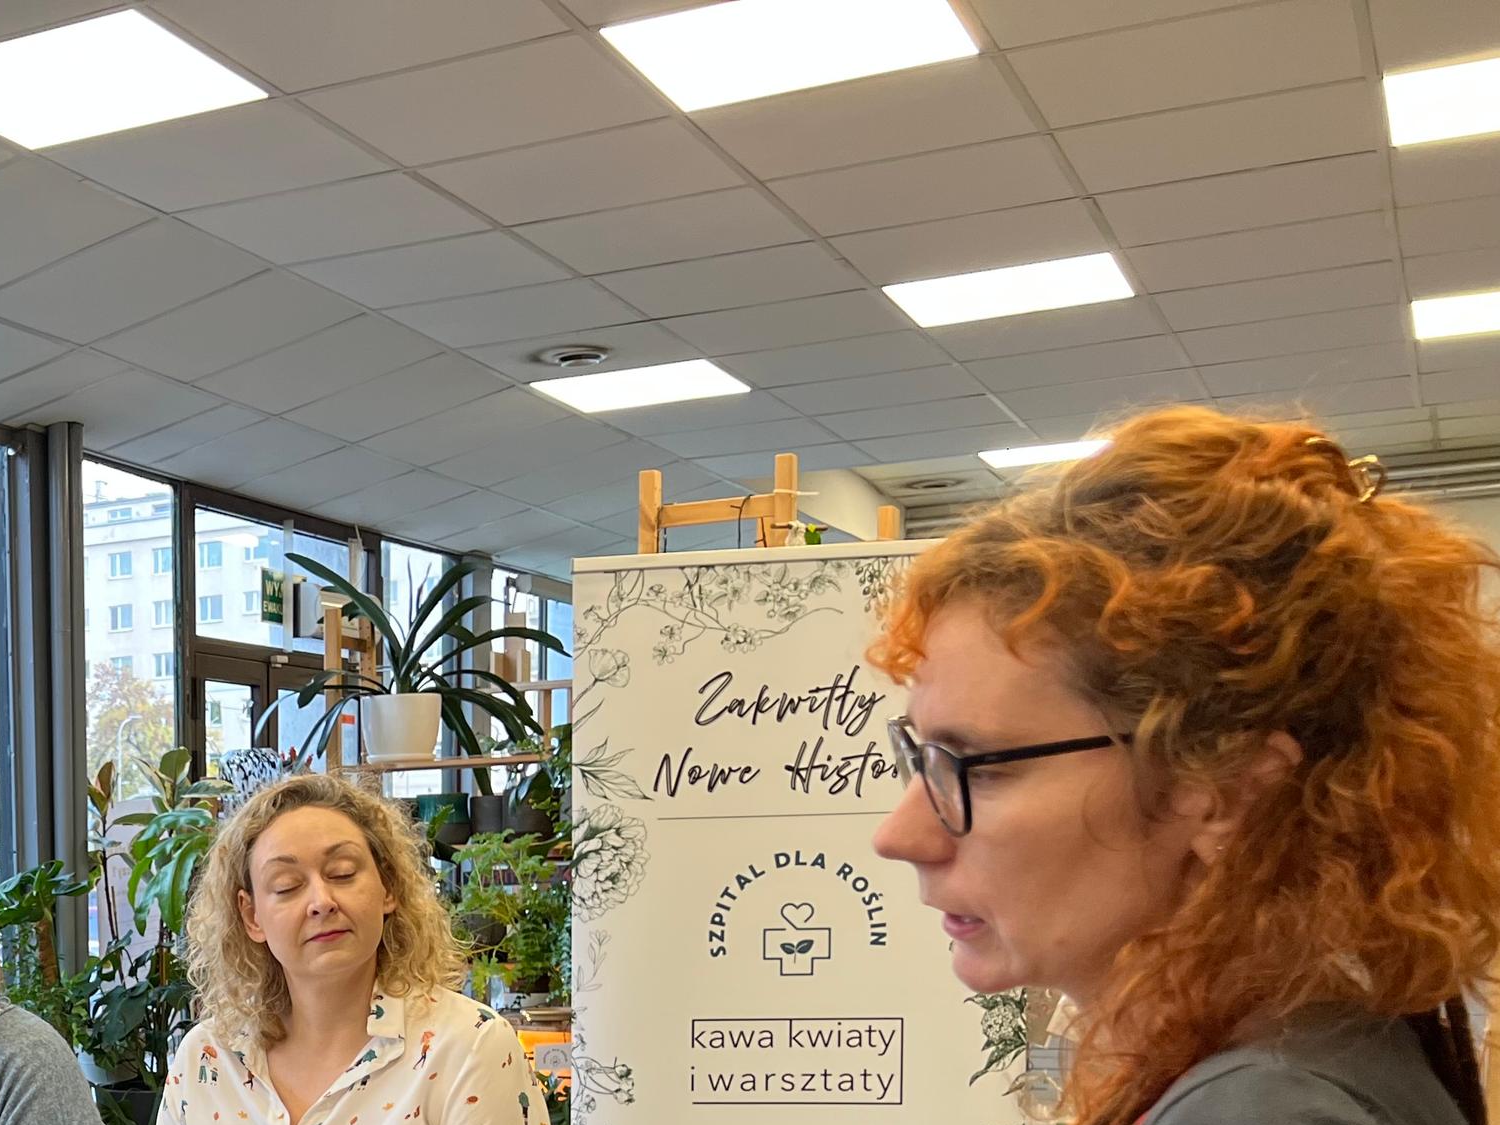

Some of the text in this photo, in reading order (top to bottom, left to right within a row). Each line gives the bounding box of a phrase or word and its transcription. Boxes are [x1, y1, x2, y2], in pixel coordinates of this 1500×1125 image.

[653, 736, 898, 797] Nowe Histo
[708, 850, 887, 958] SZPITAL DLA ROŚLIN
[691, 1019, 895, 1056] kawa kwiaty
[690, 1065, 894, 1100] i warsztaty
